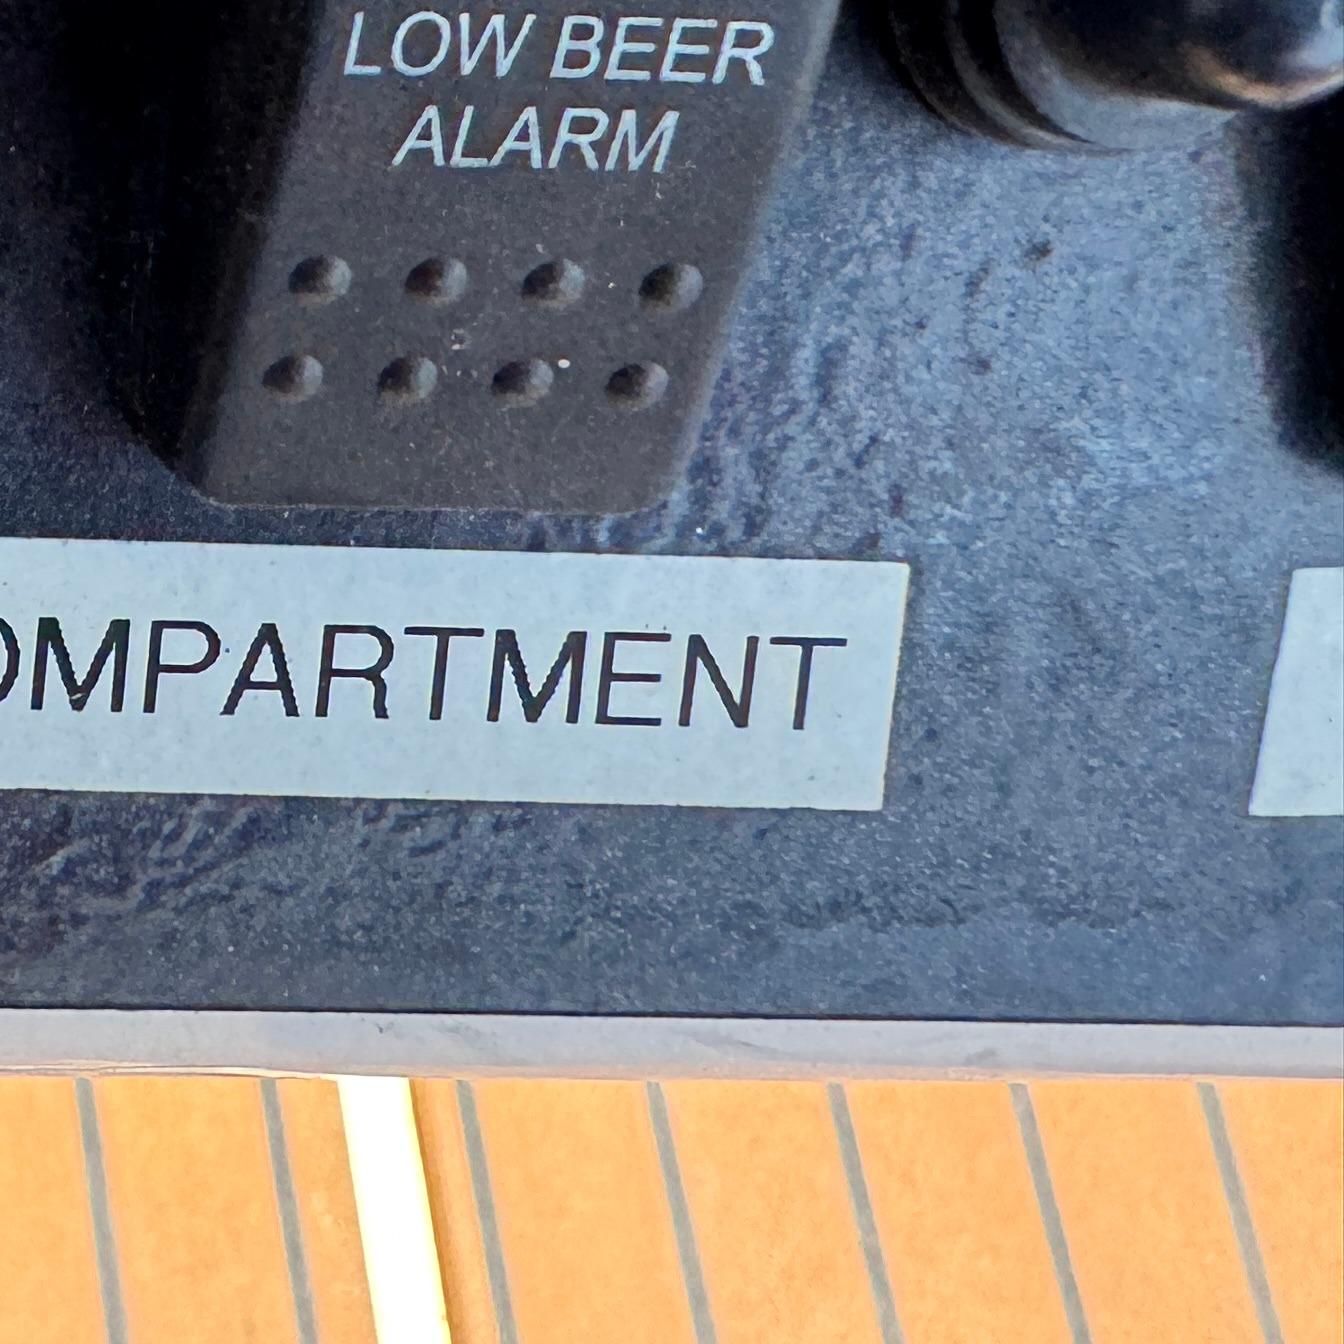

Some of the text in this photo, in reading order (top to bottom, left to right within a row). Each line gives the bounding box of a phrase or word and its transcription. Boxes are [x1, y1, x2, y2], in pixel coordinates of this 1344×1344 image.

[343, 11, 775, 85] LOW BEER
[392, 105, 680, 173] ALARM
